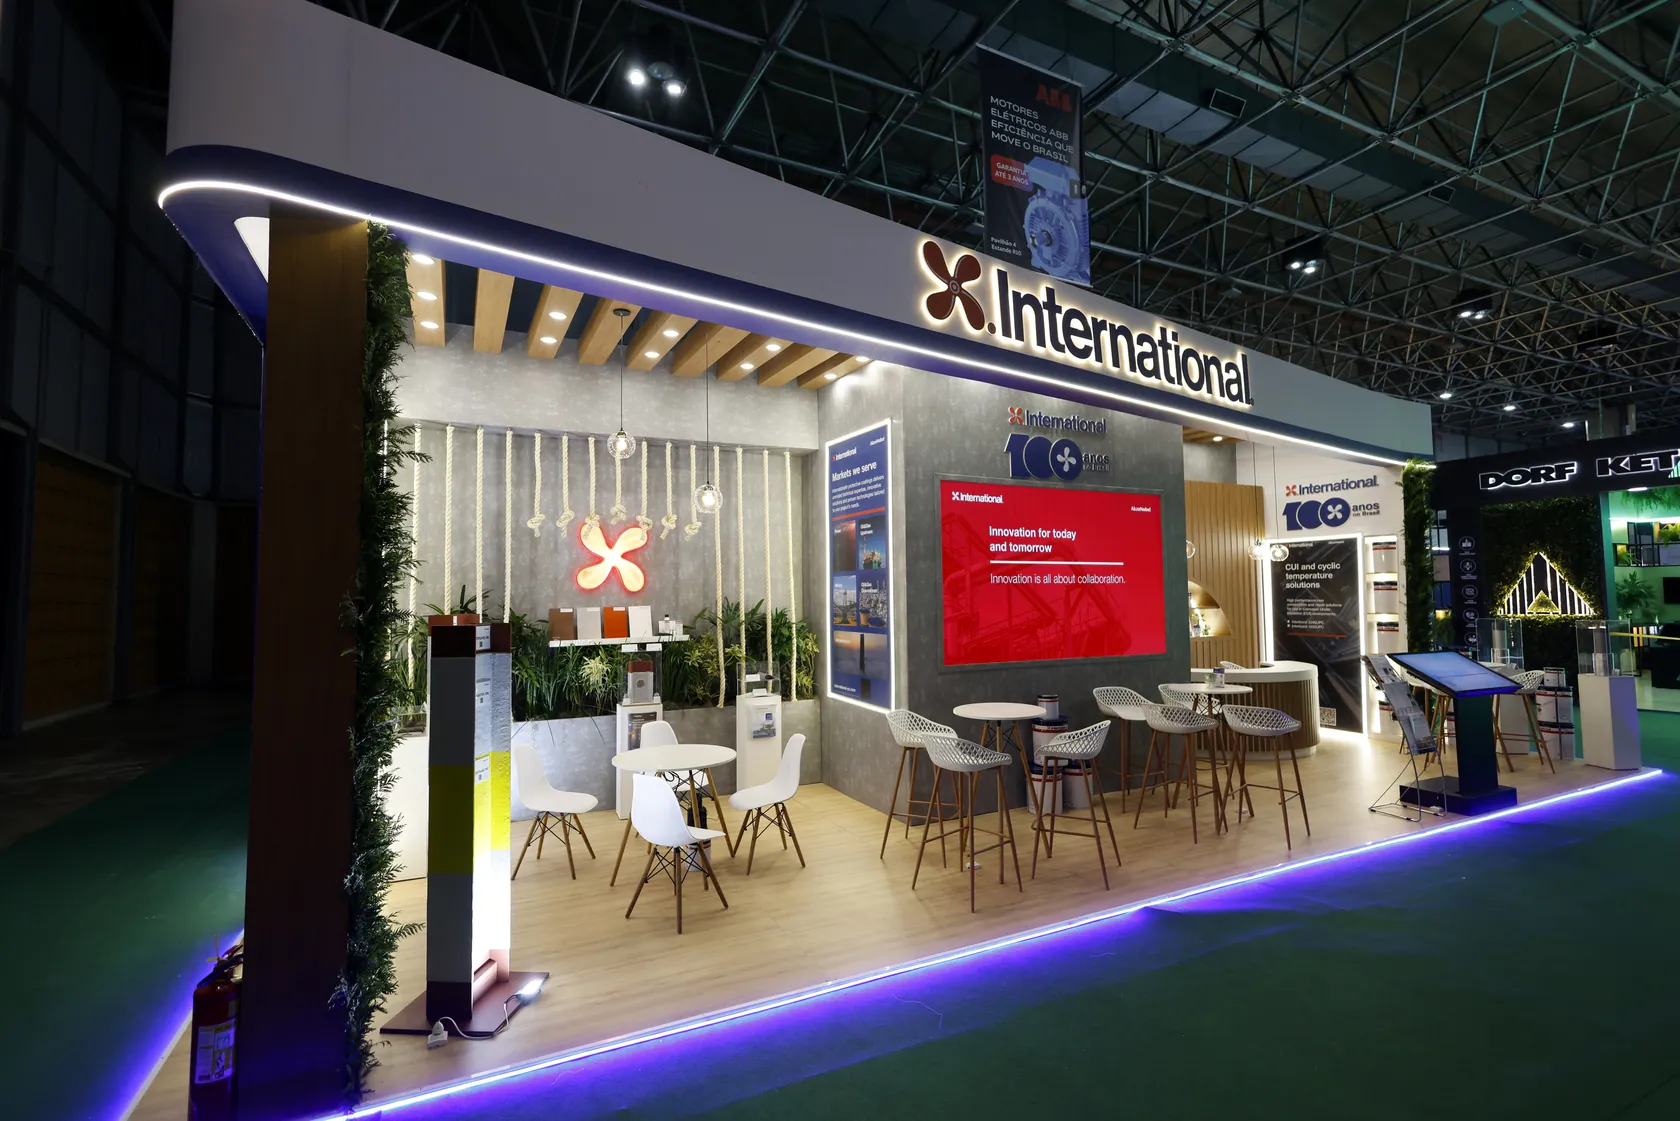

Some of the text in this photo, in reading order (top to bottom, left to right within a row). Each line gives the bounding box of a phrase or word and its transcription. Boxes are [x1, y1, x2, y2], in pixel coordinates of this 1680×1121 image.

[1036, 84, 1074, 112] ABB
[990, 96, 1038, 119] MOTORES
[991, 108, 1068, 140] ELÉTRICOS ABB
[992, 119, 1074, 153] EFICIÊNCIA QUE
[992, 131, 1068, 162] MOVE O BRASIL
[995, 170, 1006, 178] ATÉ
[1012, 175, 1029, 185] ANOS
[996, 162, 1026, 176] GARANTIA
[1082, 453, 1110, 464] anos
[832, 462, 877, 482] Markets we serve
[1478, 448, 1680, 490] DORF KET
[1282, 497, 1380, 531] 100 anos
[989, 526, 1076, 541] Innovation for today
[989, 542, 1052, 553] and tomorrow
[1318, 562, 1341, 571] cyclic
[990, 573, 1126, 584] Innovation is all about collaboration.
[1286, 572, 1333, 580] temperature
